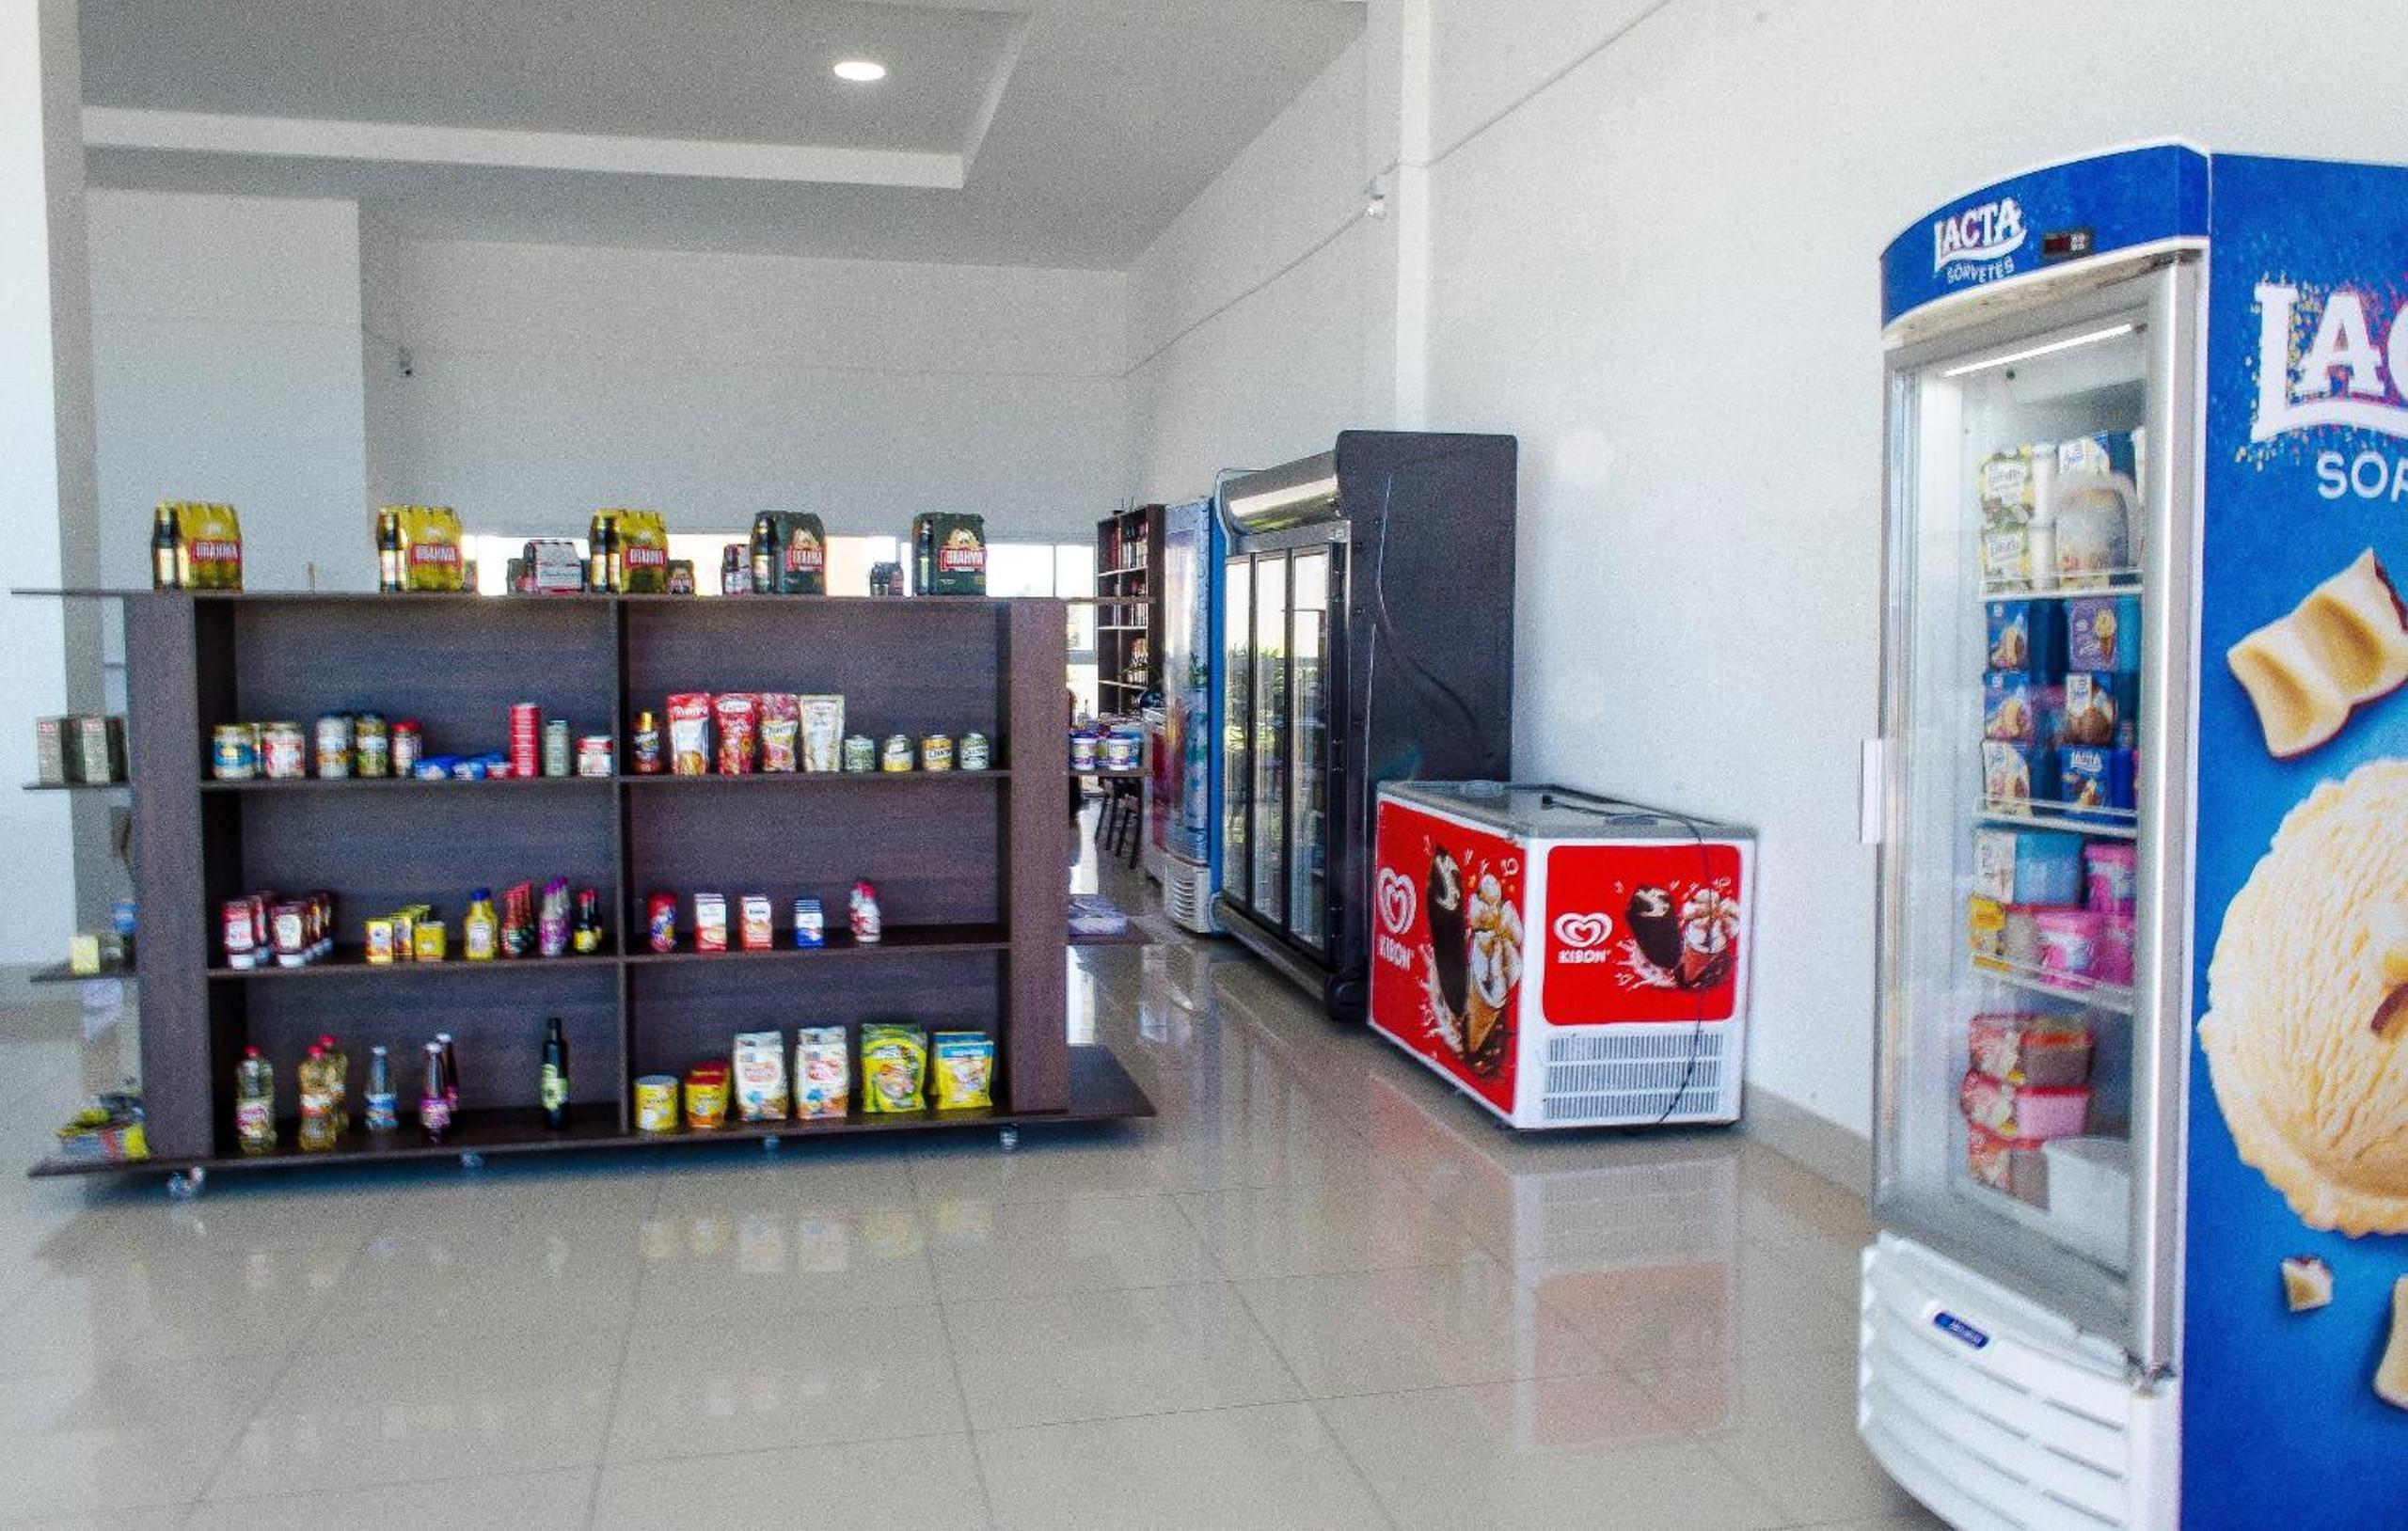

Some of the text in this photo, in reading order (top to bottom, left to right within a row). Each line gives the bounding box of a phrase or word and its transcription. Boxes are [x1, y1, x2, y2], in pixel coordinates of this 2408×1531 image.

[1934, 197, 2027, 273] LACTA
[1947, 255, 2015, 284] SORVETES
[2251, 283, 2408, 443] LA
[1380, 936, 1411, 971] KIBON
[1558, 949, 1607, 964] KIBON
